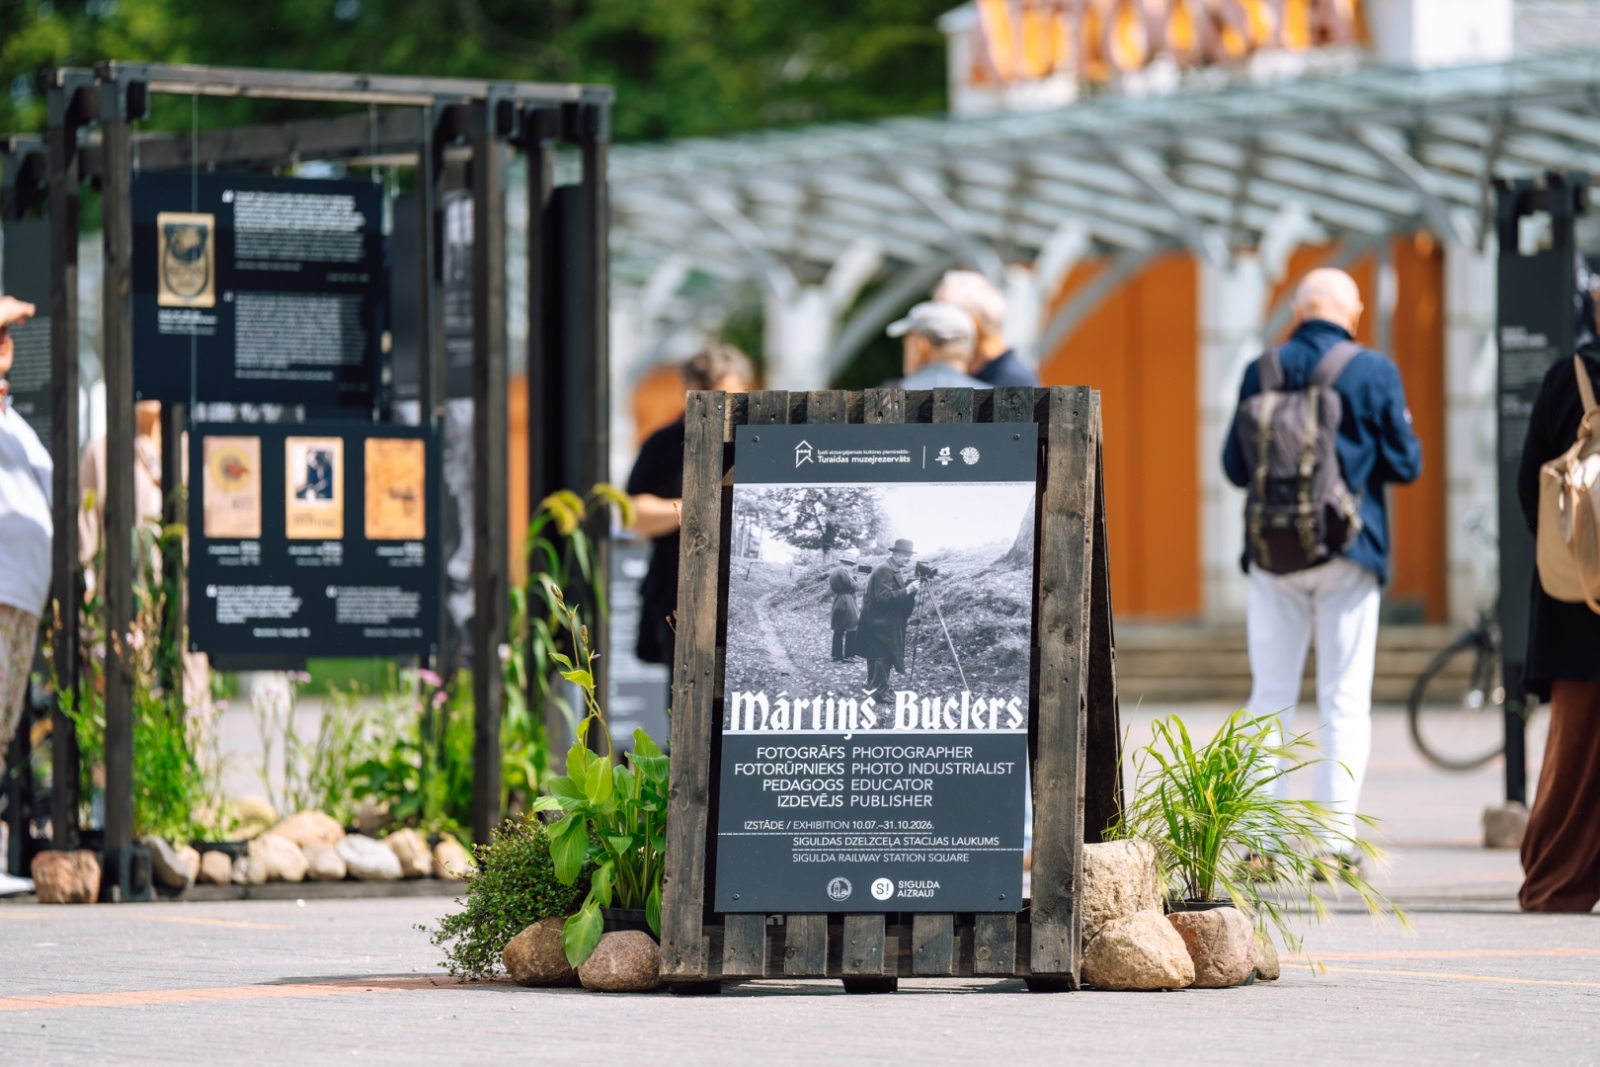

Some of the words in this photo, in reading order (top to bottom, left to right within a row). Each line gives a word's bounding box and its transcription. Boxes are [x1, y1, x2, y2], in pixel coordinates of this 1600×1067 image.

[817, 455, 849, 463] Turaidas
[851, 455, 911, 464] muzejrezervāts
[893, 690, 1024, 731] Buclers
[757, 745, 845, 759] FOTOGRĀFS
[852, 746, 973, 759] PHOTOGRAPHER
[734, 761, 845, 775] FOTORŪPNIEKS
[851, 763, 904, 775] PHOTO
[908, 762, 1015, 775] INDUSTRIALIST
[763, 779, 844, 791] PEDAGOGS
[851, 779, 933, 791] EDUCATOR
[777, 793, 844, 807] IZDEVĒJS
[850, 795, 933, 807] PUBLISHER
[744, 820, 784, 830] IZSTĀDE
[793, 820, 850, 830] EXHIBITION
[793, 837, 842, 846] SIGULDAS
[844, 837, 901, 848] DZELZCEĻA
[903, 836, 948, 846] STACIJAS
[951, 836, 1000, 846] LAUKUMS
[792, 853, 836, 863] SIGULDA
[838, 853, 881, 862] RAILWAY
[883, 853, 926, 862] STATION
[928, 853, 969, 862] SQUARE
[876, 882, 890, 896] S!
[897, 889, 934, 898] AIZRAUJ
